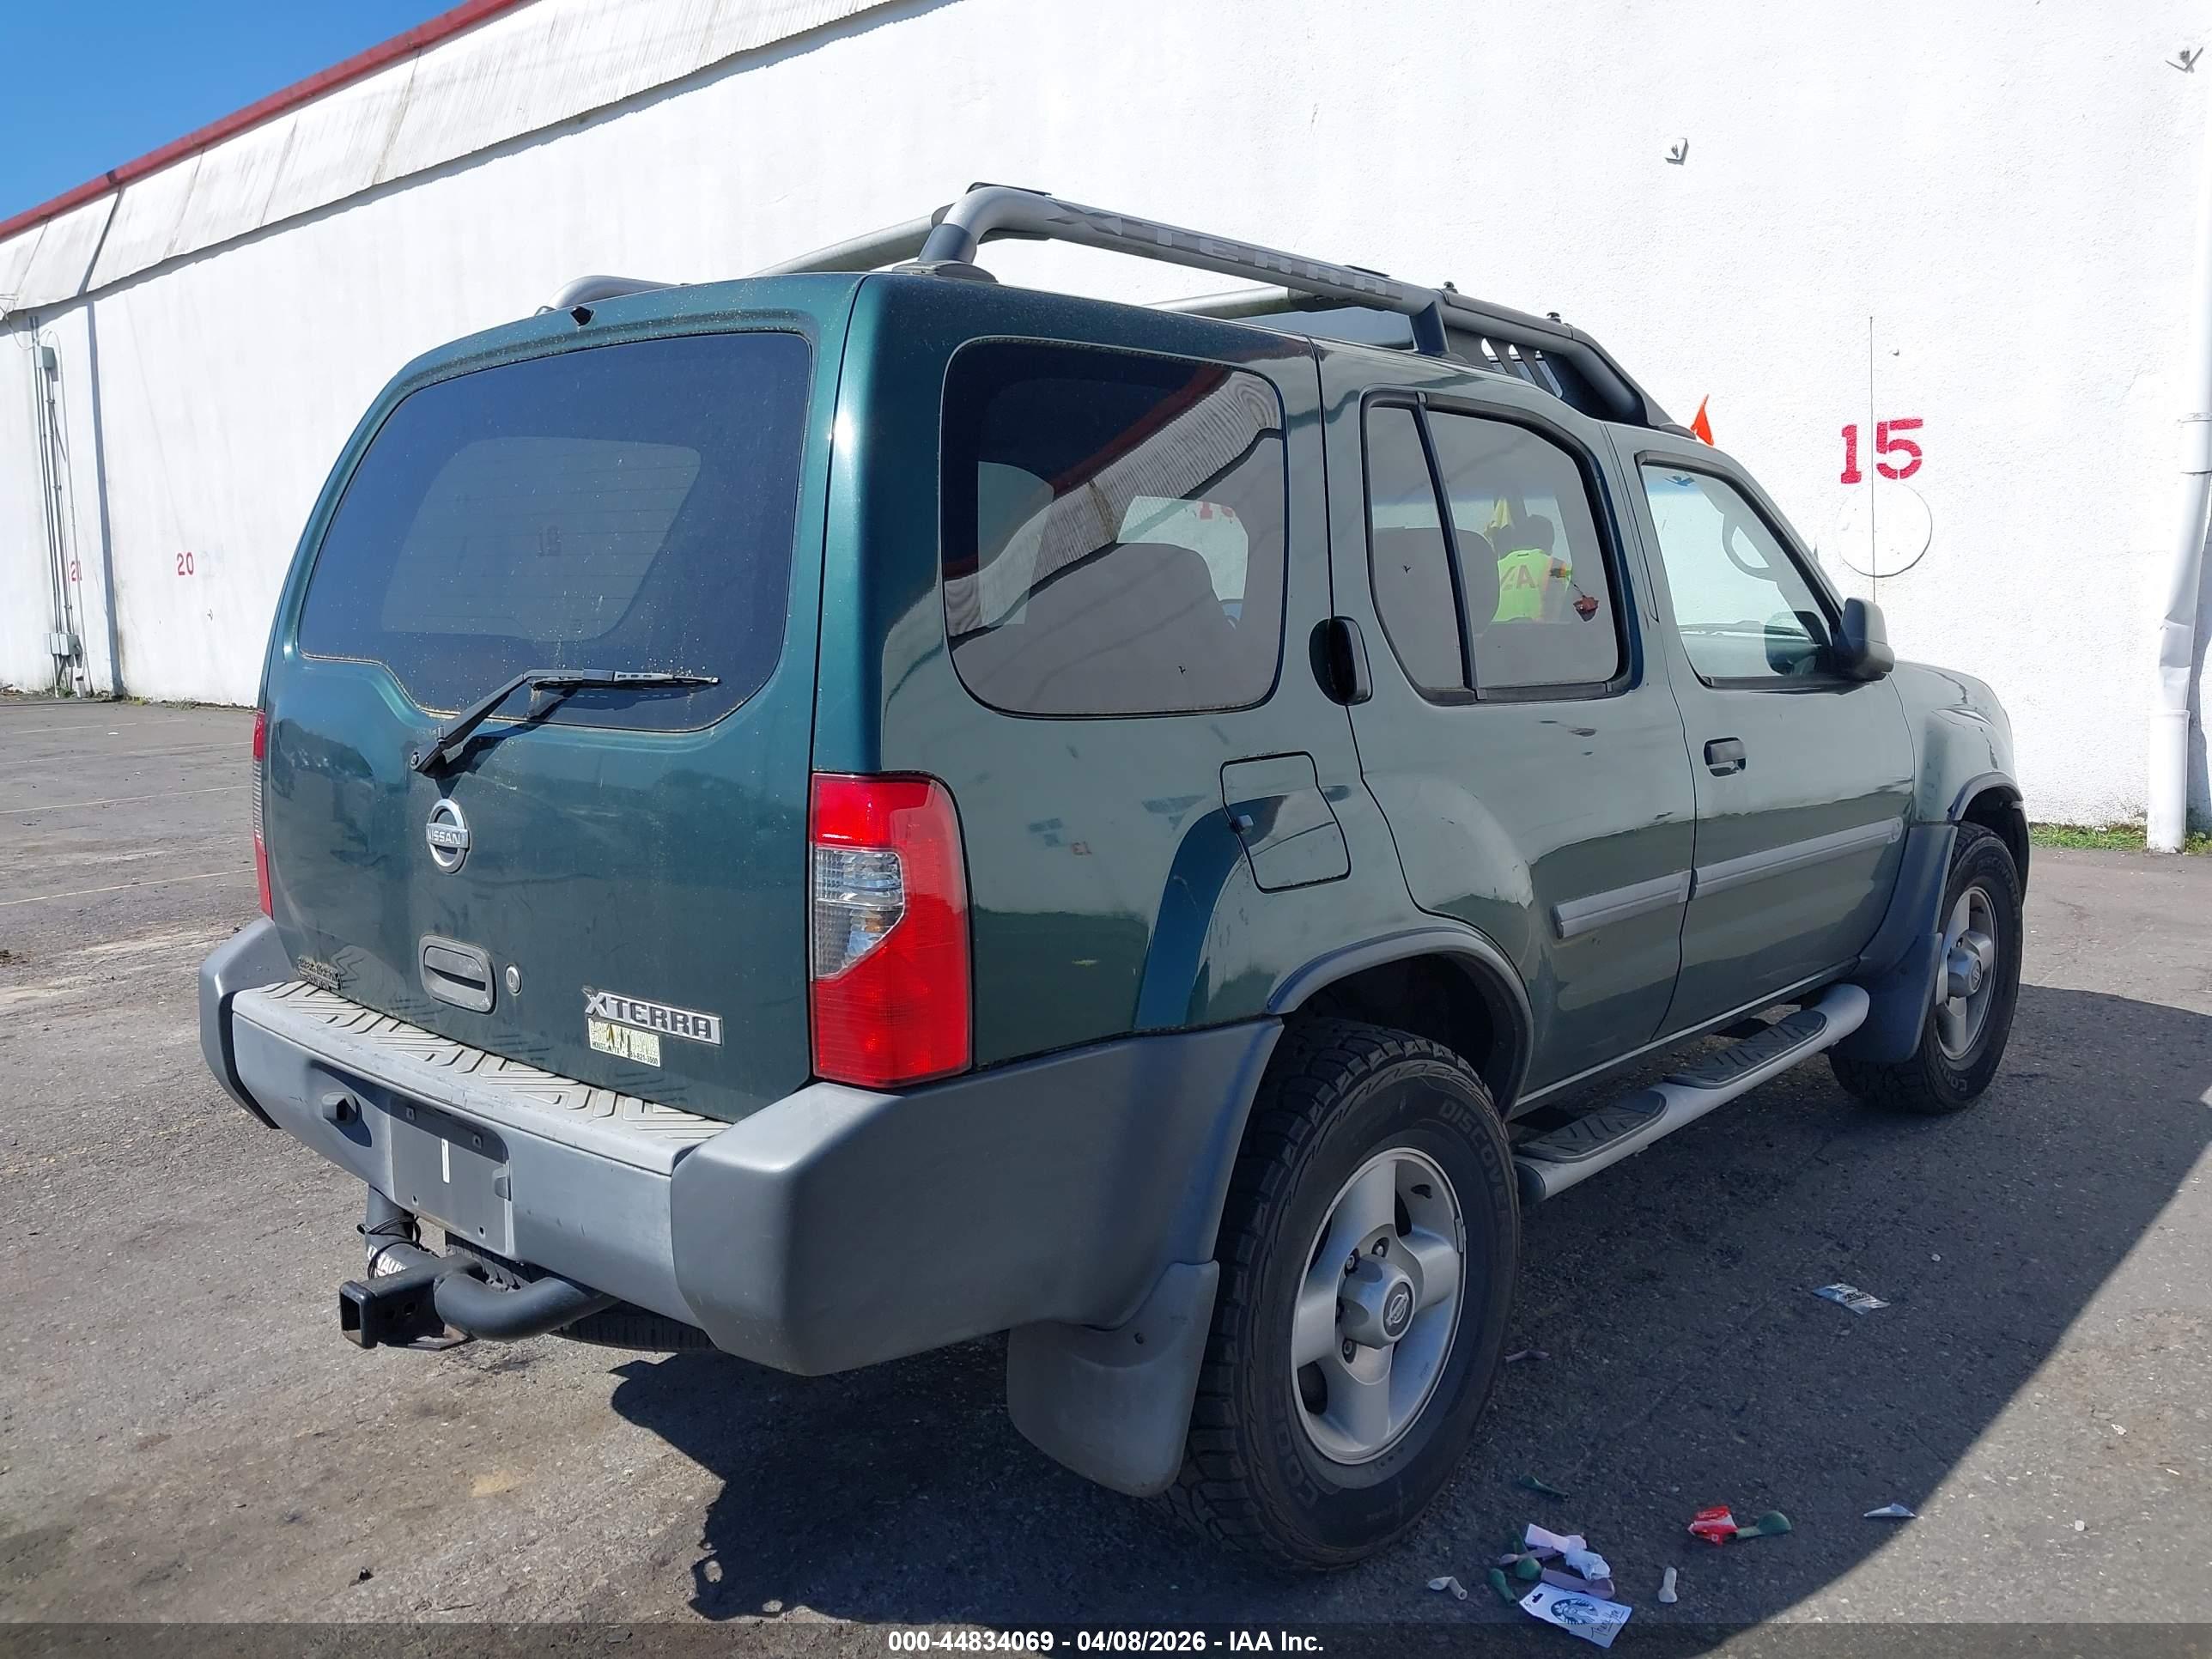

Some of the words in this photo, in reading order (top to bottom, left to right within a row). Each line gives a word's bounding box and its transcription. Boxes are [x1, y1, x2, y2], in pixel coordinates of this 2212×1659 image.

[1044, 201, 1401, 301] XTERRA
[1840, 418, 1923, 484] 15
[176, 552, 194, 576] 20
[427, 828, 462, 846] NISSAN
[581, 985, 723, 1046] XTERRA
